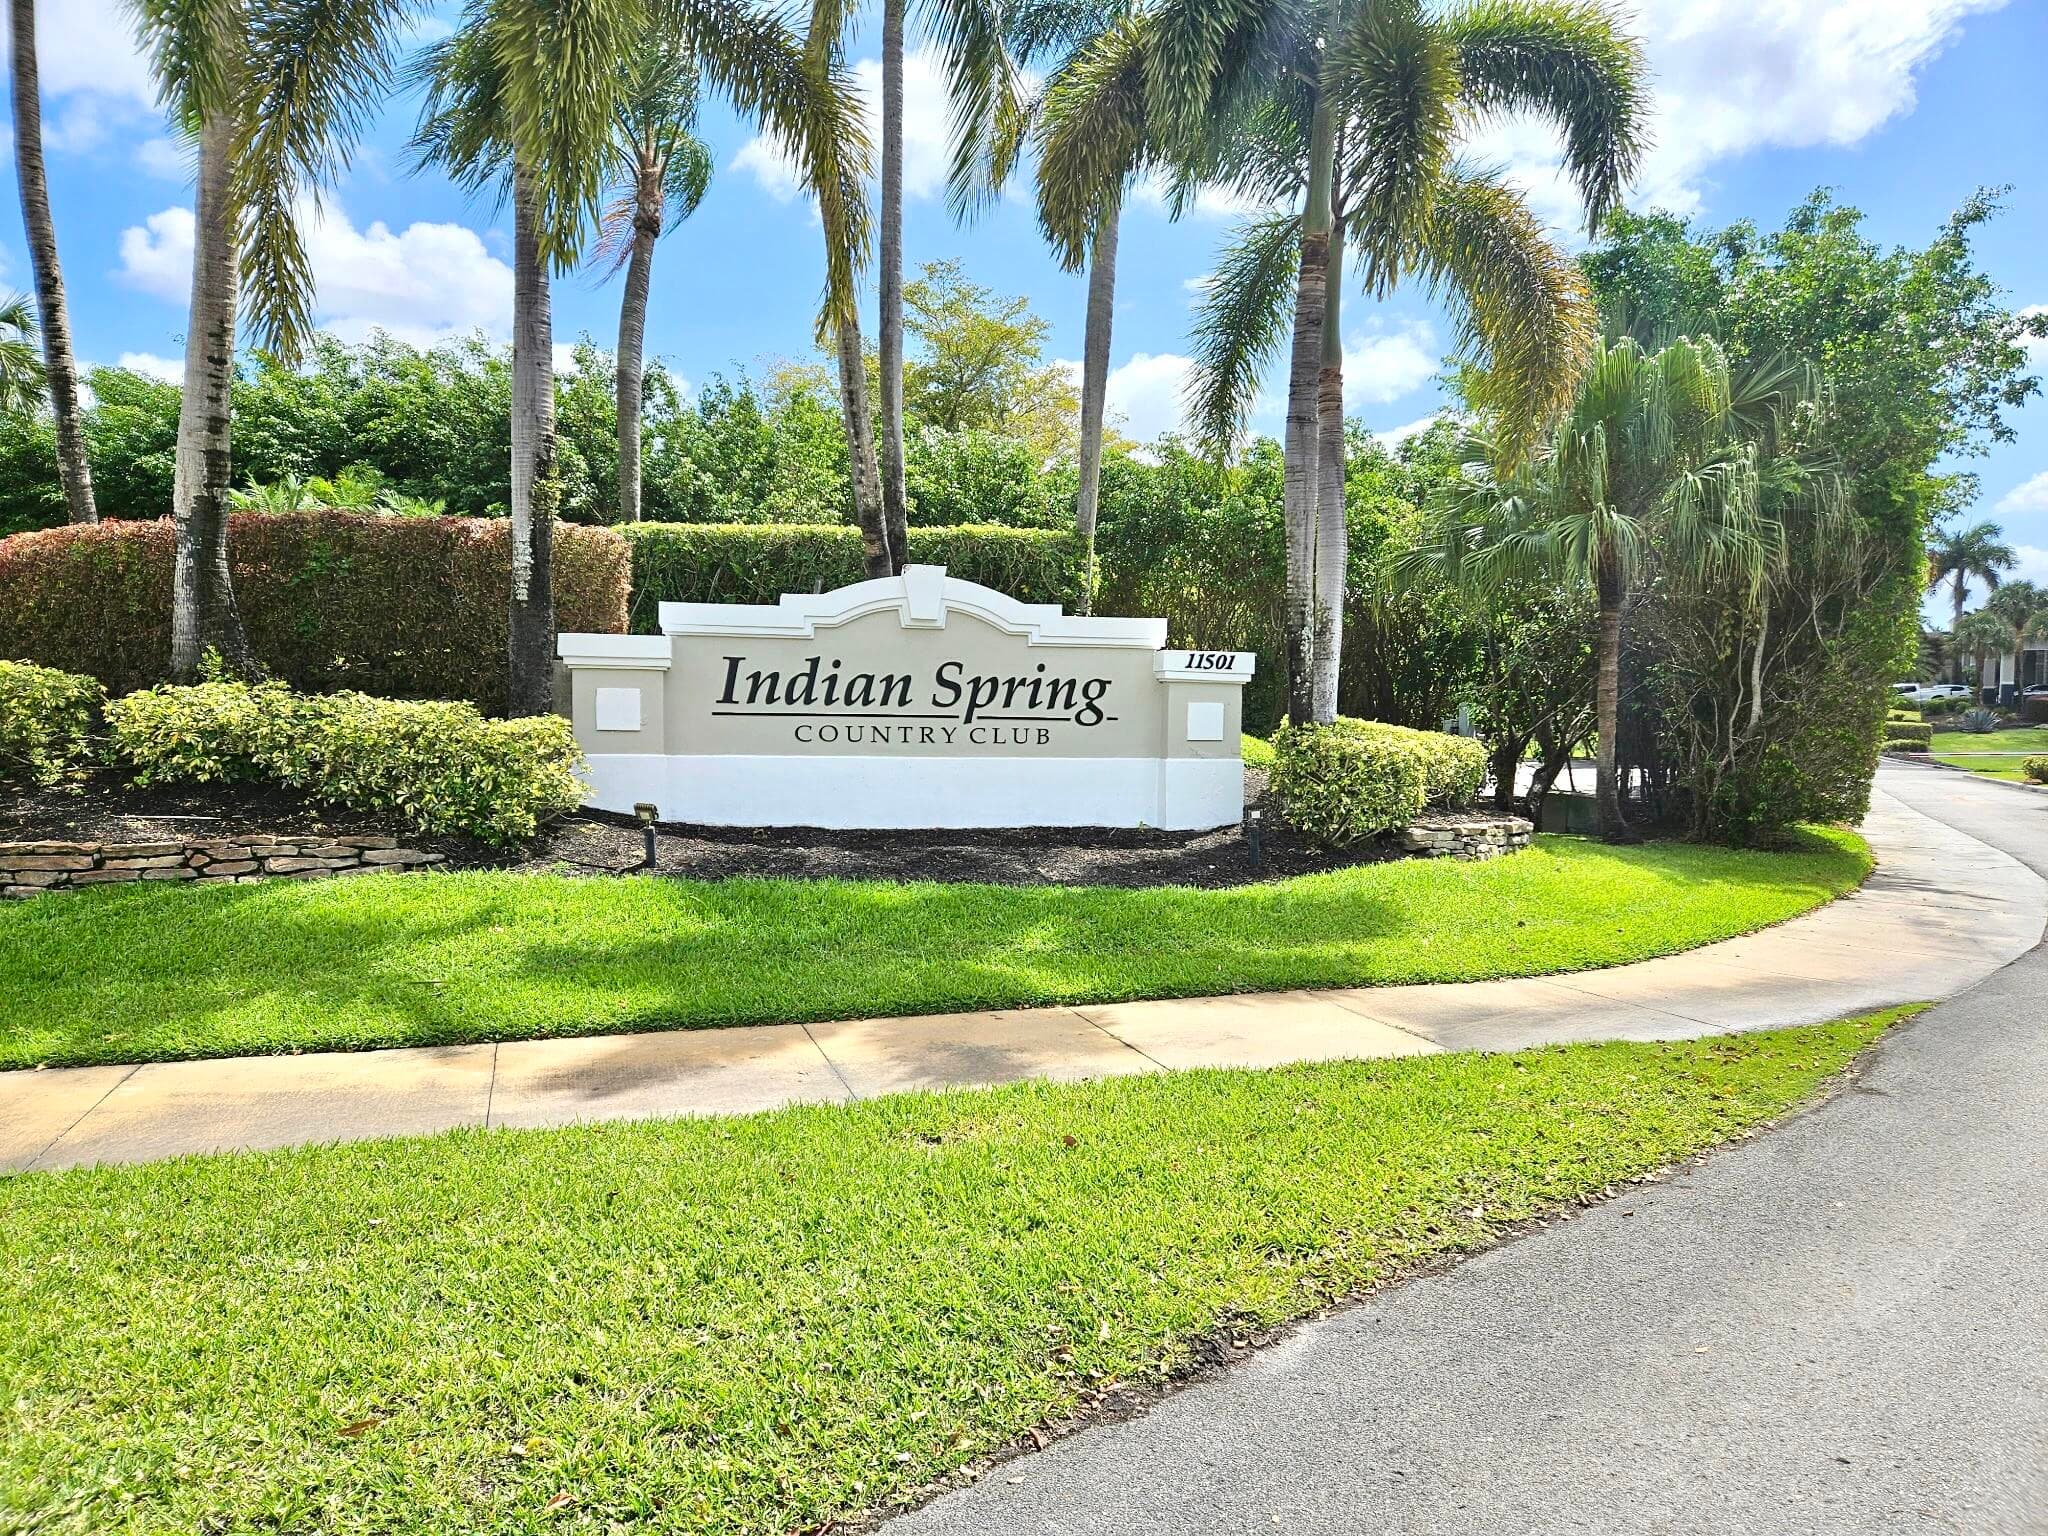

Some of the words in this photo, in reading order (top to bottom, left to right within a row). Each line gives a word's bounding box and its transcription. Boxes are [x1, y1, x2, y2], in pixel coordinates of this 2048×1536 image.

[1184, 653, 1236, 670] 11501
[715, 655, 913, 707] Indian
[931, 660, 1113, 726] Spring
[794, 724, 957, 744] COUNTRY
[969, 727, 1050, 745] CLUB
